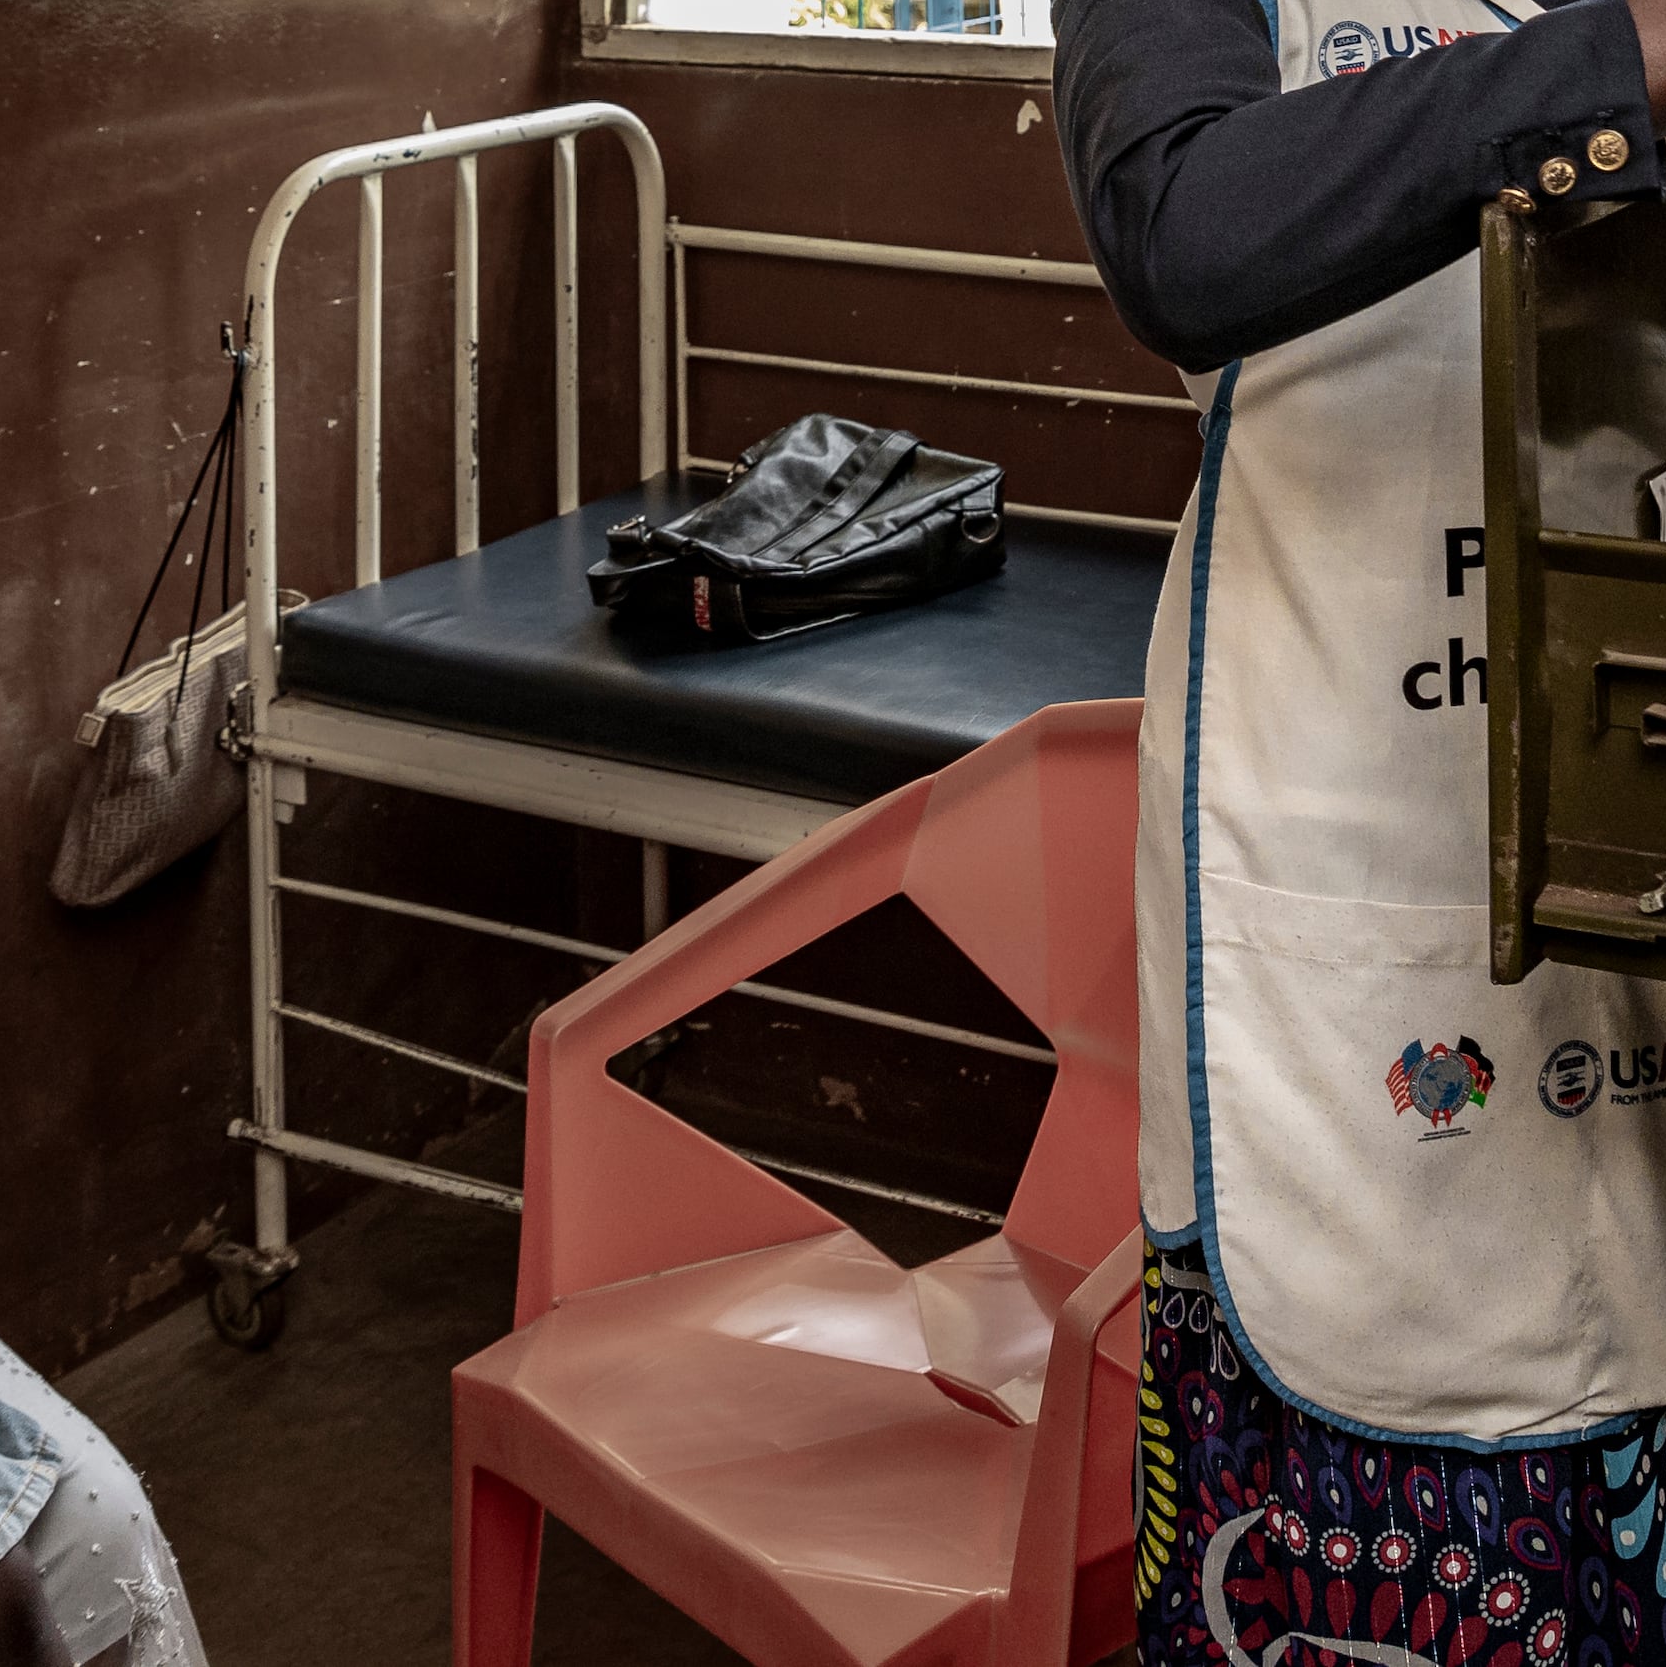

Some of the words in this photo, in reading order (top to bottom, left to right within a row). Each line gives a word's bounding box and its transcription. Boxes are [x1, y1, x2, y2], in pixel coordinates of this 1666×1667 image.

[1336, 36, 1360, 46] USAID
[1381, 25, 1480, 58] USA
[1401, 636, 1488, 711] ch
[1610, 1093, 1639, 1106] FROM
